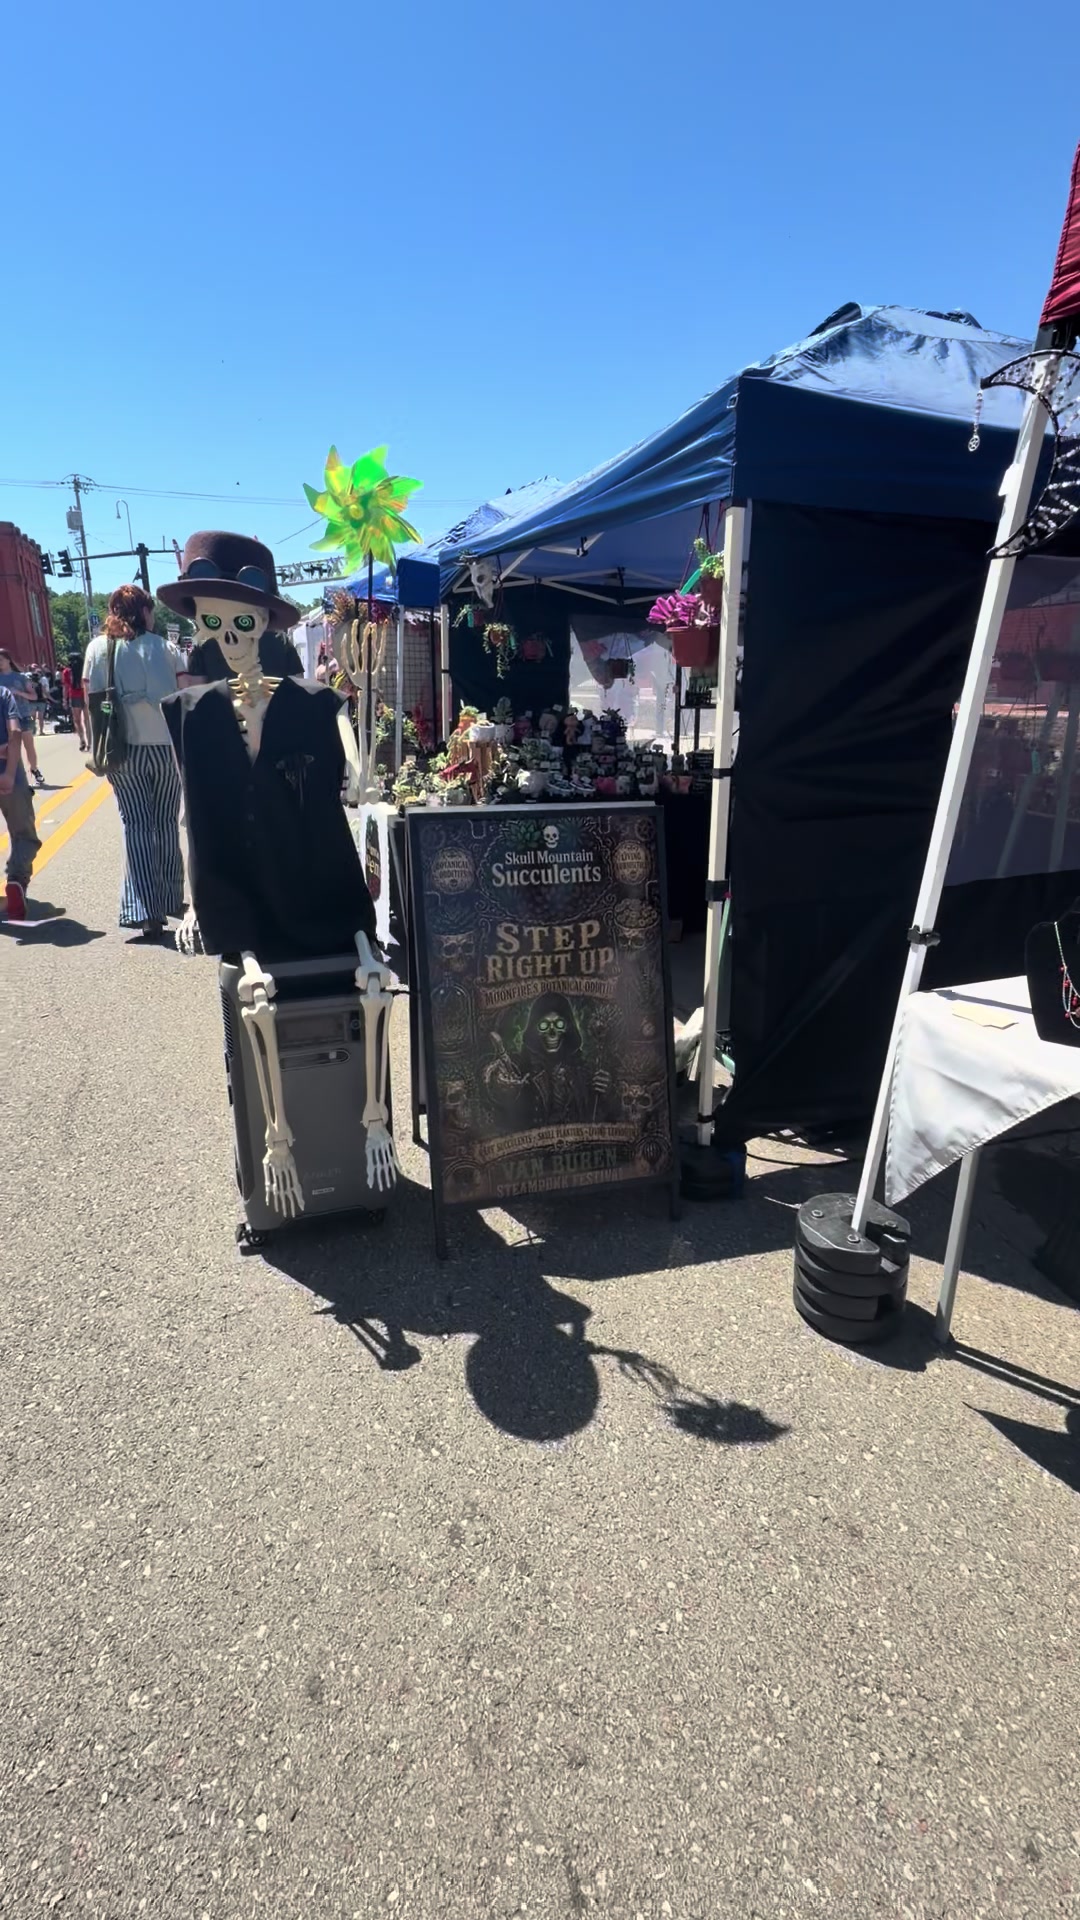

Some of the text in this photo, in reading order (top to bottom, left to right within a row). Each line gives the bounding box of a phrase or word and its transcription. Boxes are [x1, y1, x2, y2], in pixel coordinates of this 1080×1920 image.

[505, 849, 594, 865] Skull Mountain
[491, 862, 602, 887] Succulents
[496, 919, 601, 954] STEP
[484, 946, 615, 983] RIGHT UP
[541, 980, 582, 993] BOTANICAL
[500, 1148, 617, 1182] VAN BUREN
[496, 1167, 624, 1199] STEAMPUNK FESTIVAL
